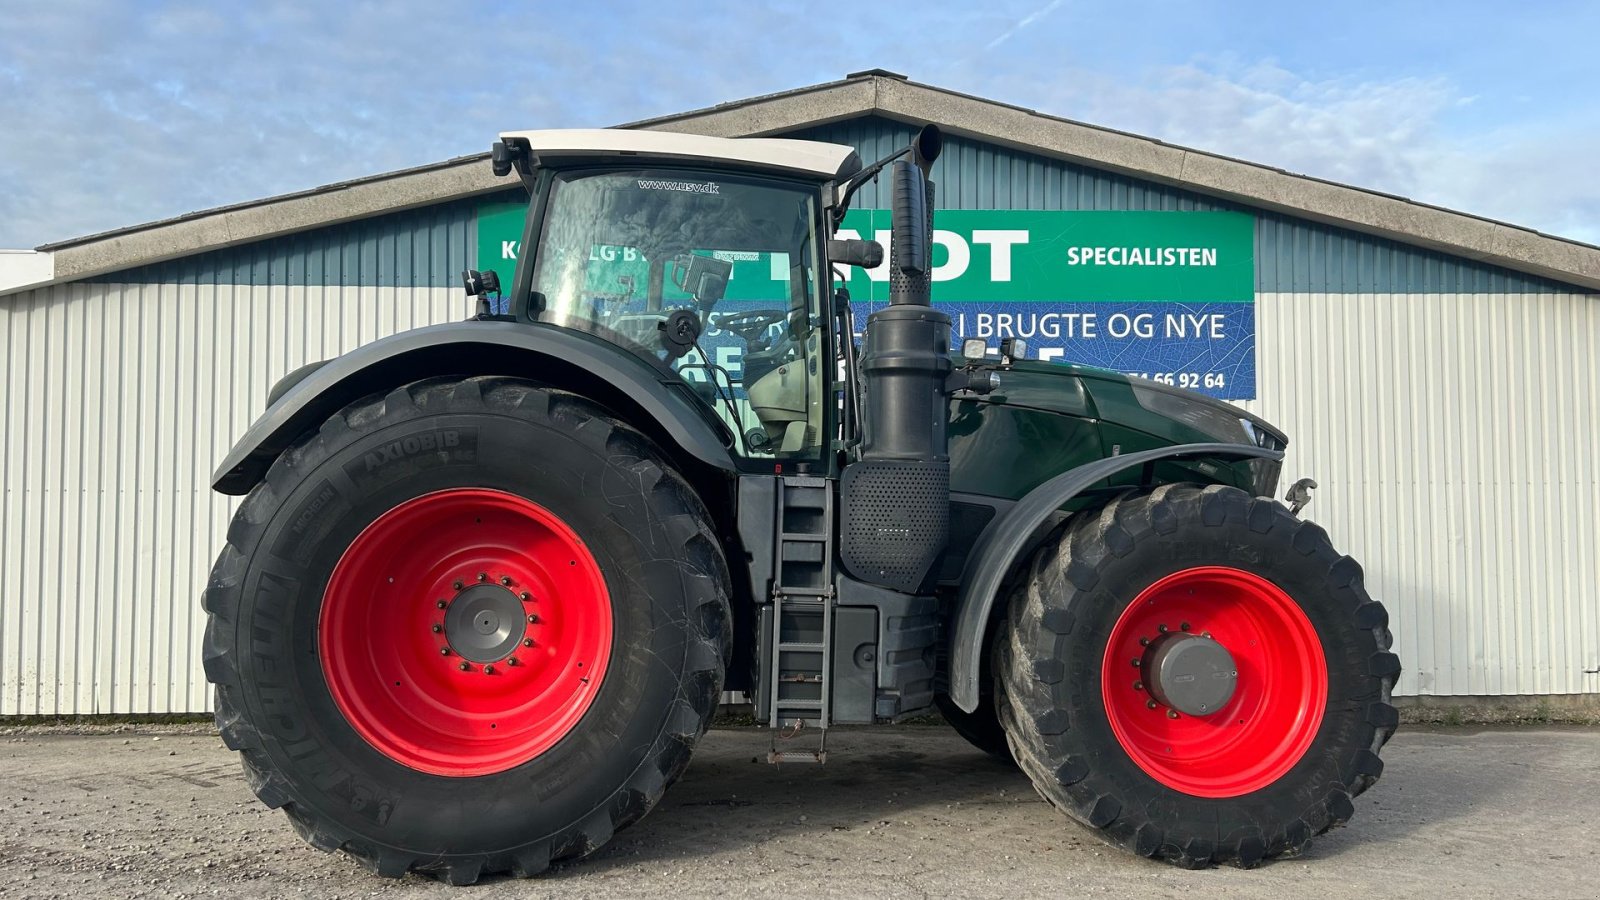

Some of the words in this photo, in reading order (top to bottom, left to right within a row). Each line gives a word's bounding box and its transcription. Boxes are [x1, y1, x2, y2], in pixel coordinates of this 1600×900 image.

[637, 180, 720, 195] www.usv.dk
[1067, 247, 1218, 267] SPECIALISTEN
[977, 313, 1096, 339] BRUGTE
[1107, 313, 1154, 339] OG
[1165, 314, 1225, 338] NYE
[1178, 373, 1200, 388] 92
[1204, 373, 1225, 388] 64
[364, 430, 460, 472] AXIOBIB
